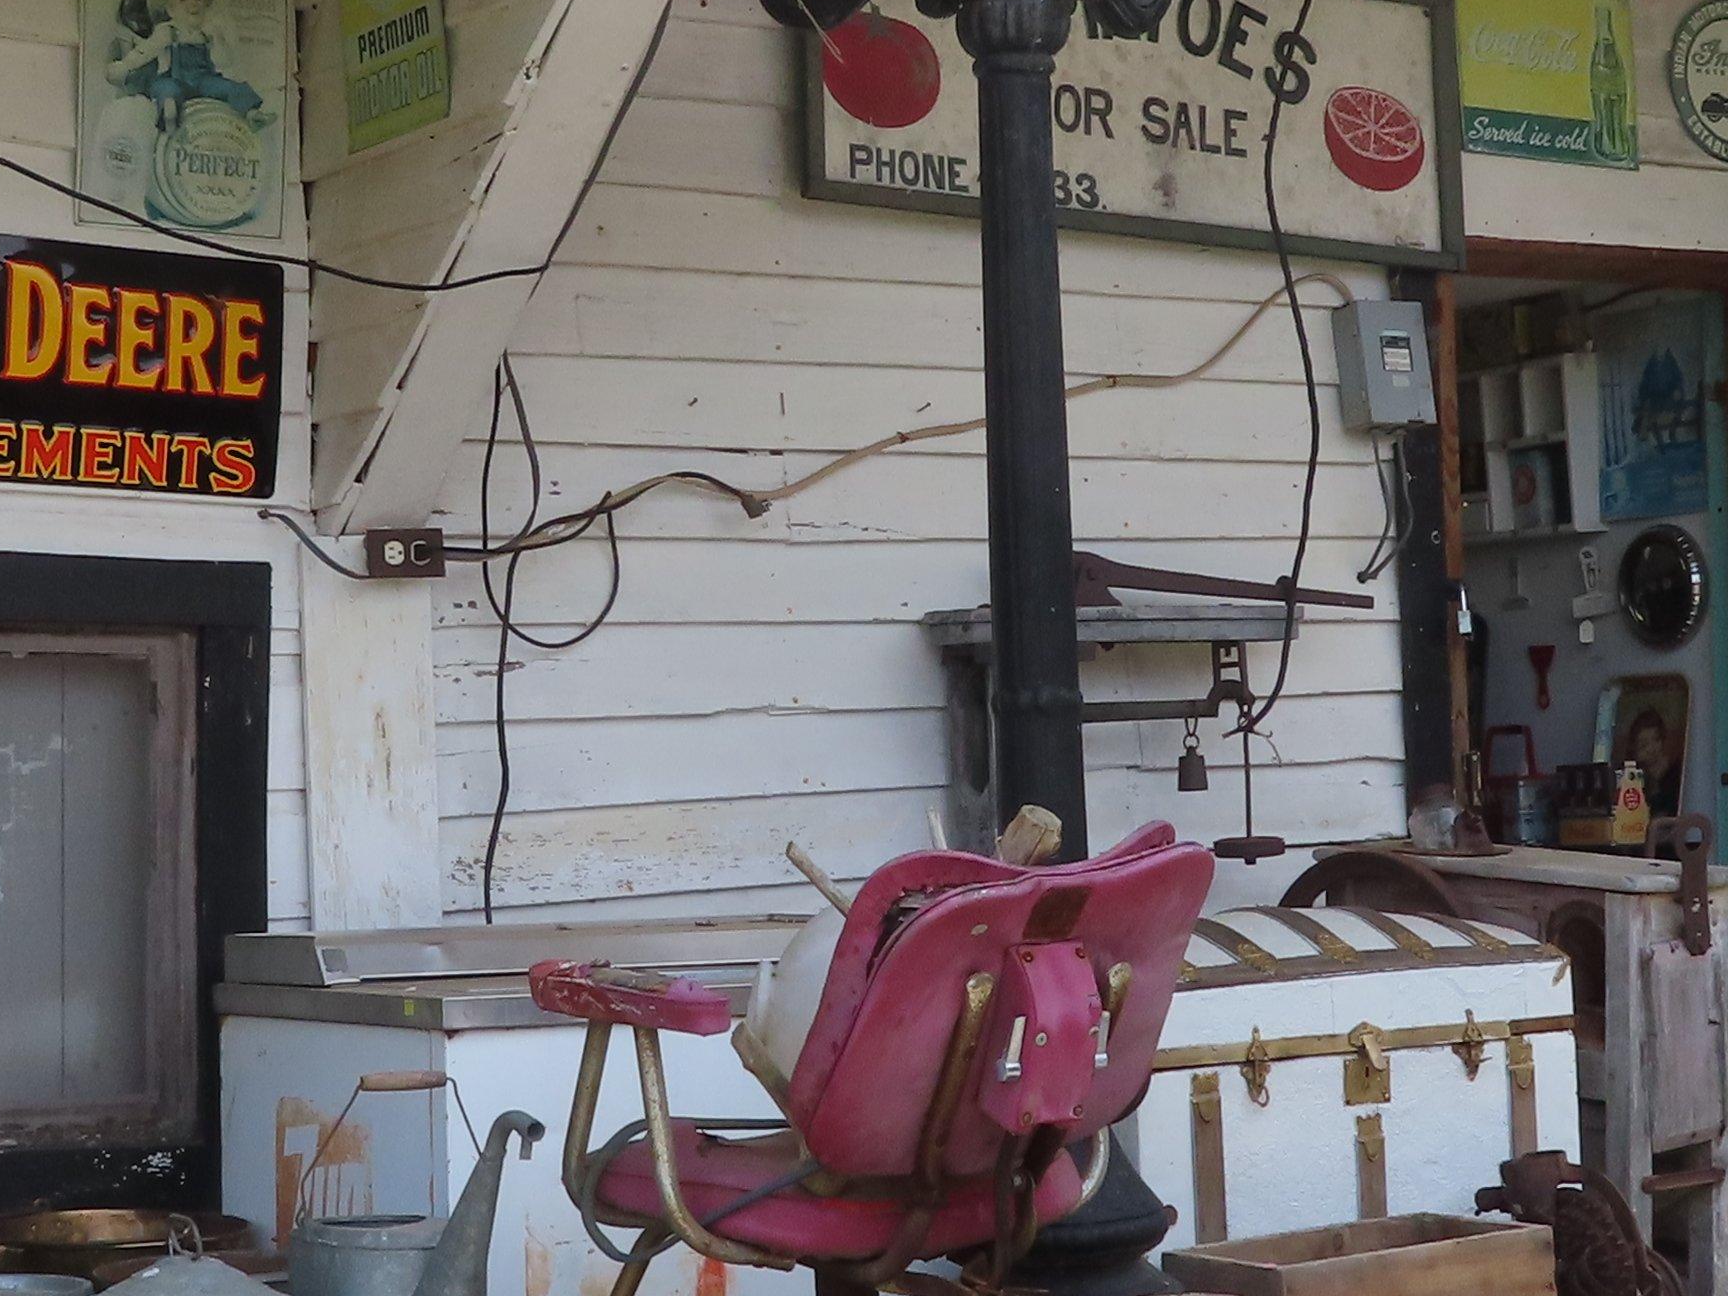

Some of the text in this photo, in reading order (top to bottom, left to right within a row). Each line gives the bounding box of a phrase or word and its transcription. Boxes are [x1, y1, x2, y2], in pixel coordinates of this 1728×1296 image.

[358, 6, 431, 64] PREMIUM
[1674, 30, 1693, 79] INDIAN
[352, 45, 443, 125] MOTOR OIL
[1053, 84, 1249, 159] OR SALE
[1468, 115, 1588, 151] Served ice cold
[848, 142, 970, 194] PHONE
[0, 257, 267, 399] DEERE
